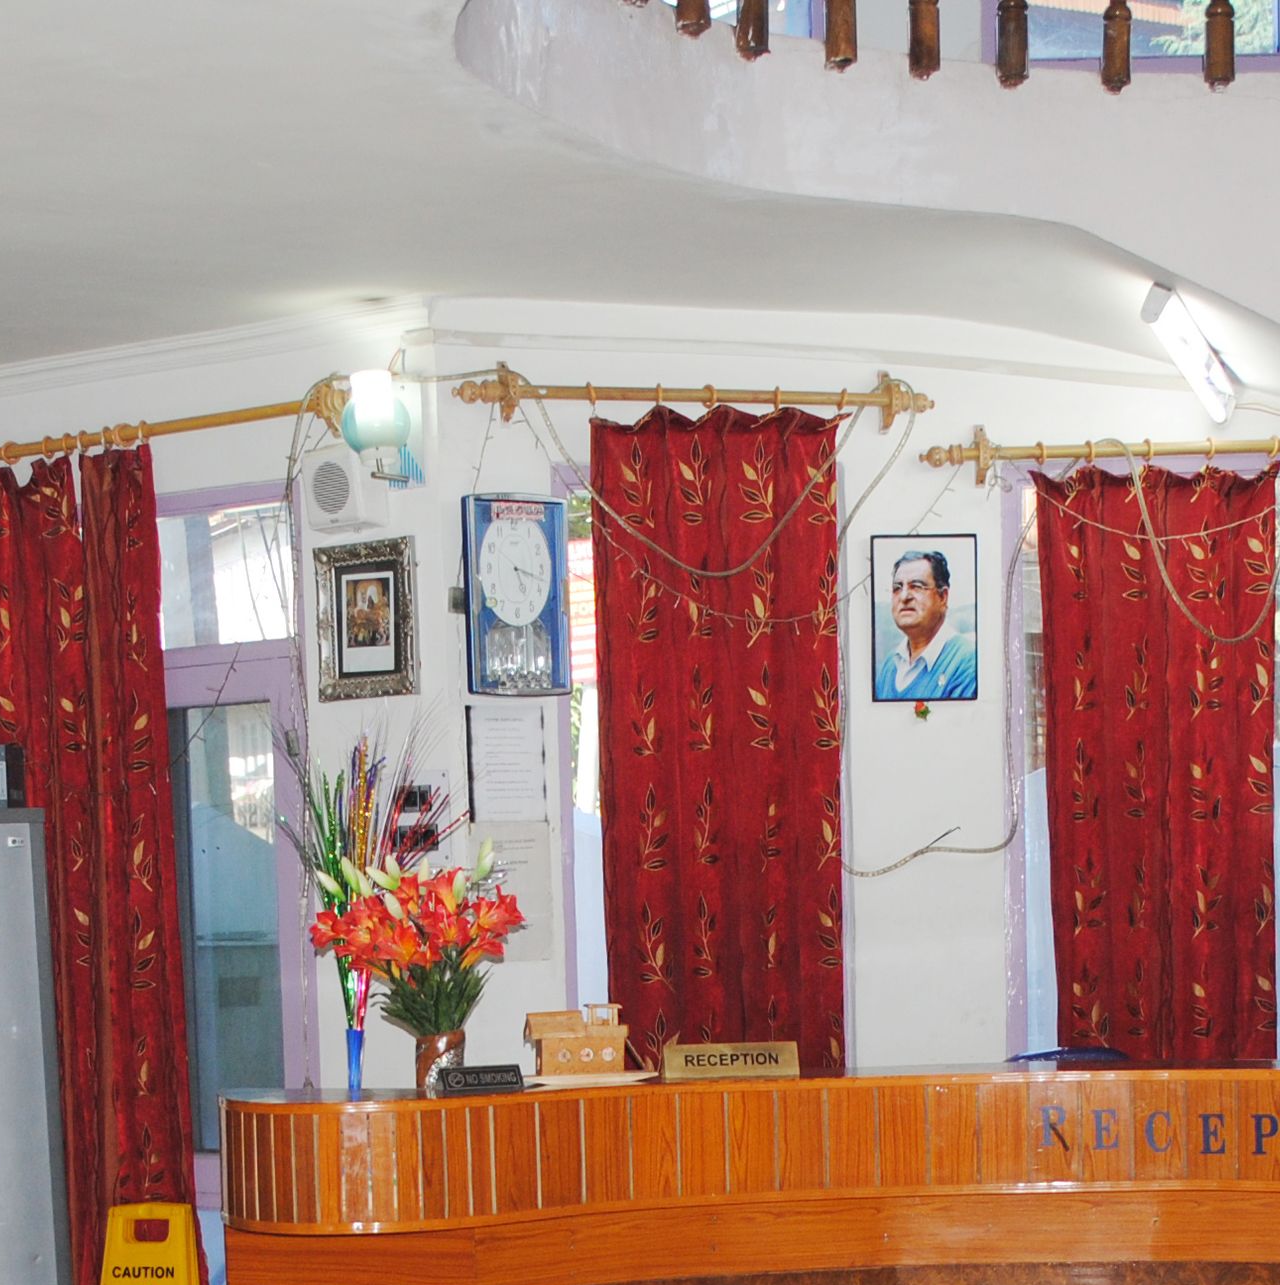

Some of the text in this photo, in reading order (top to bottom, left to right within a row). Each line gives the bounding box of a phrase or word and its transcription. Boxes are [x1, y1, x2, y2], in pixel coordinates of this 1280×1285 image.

[684, 1052, 780, 1067] RECEPTION
[465, 1071, 517, 1085] NO SMOKING
[112, 1266, 174, 1278] CAUTION
